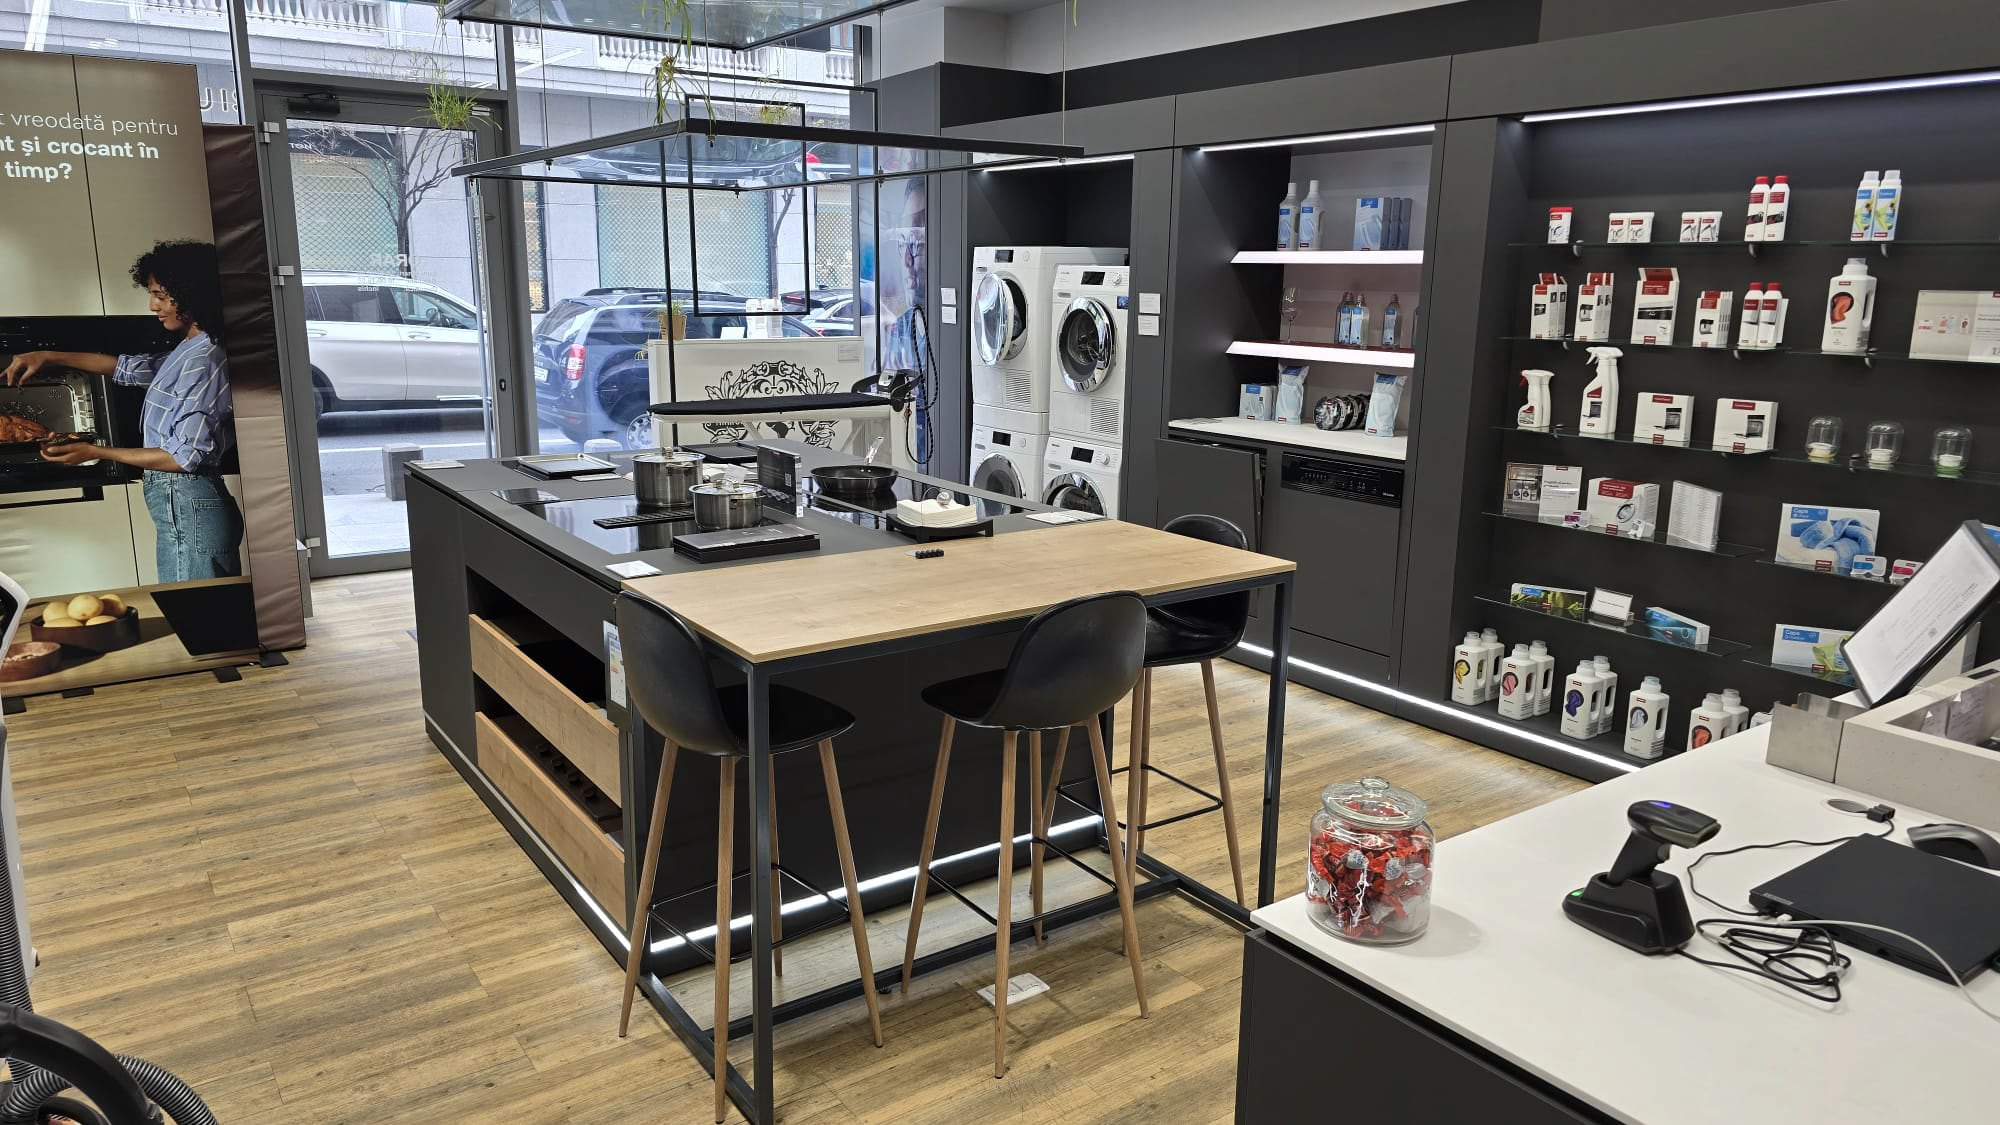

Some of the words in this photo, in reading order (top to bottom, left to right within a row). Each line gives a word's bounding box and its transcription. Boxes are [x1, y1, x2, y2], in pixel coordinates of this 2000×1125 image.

[10, 112, 105, 131] vreodată
[112, 119, 178, 136] pentru
[21, 135, 41, 156] și
[47, 140, 134, 158] crocant
[137, 141, 159, 159] în
[4, 161, 72, 183] timp?
